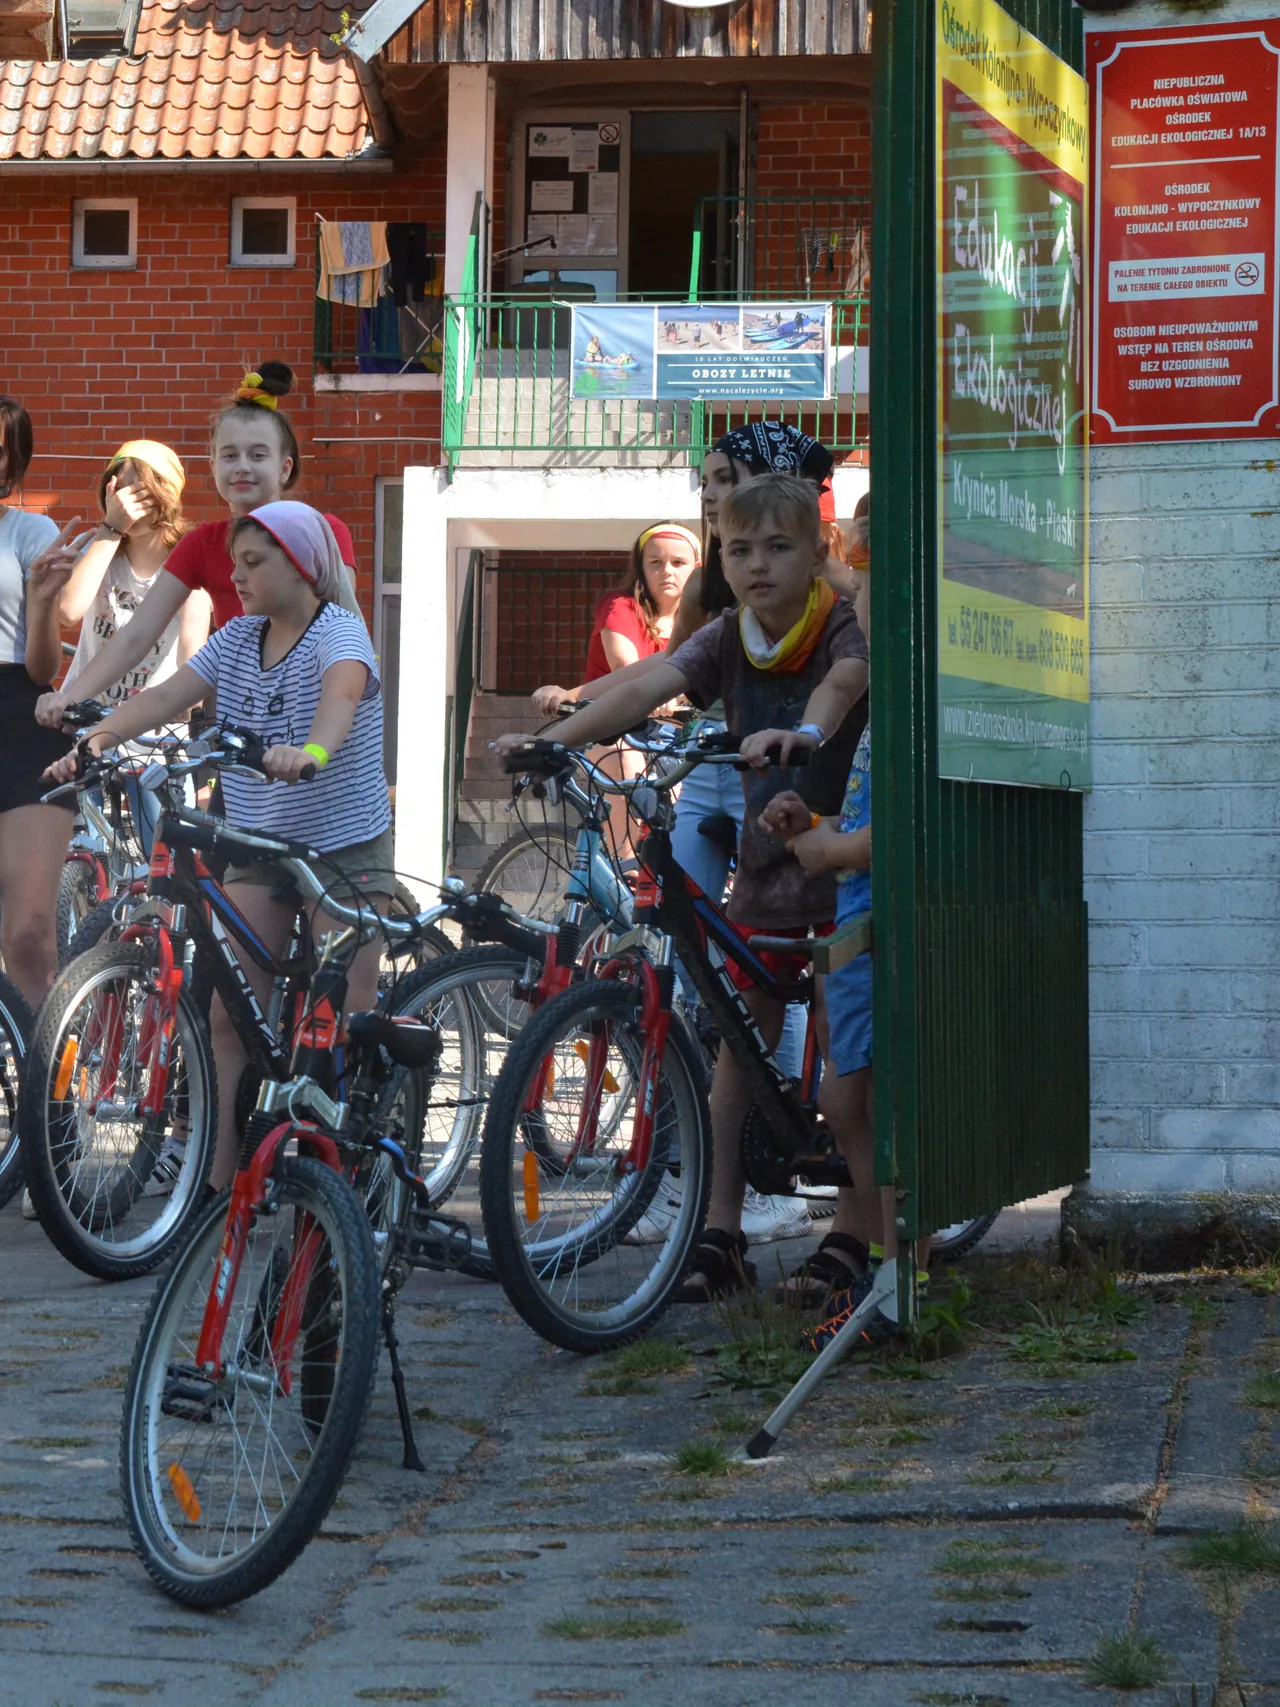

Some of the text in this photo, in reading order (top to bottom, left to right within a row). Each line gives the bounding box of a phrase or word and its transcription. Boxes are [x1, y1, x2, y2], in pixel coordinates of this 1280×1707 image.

[942, 0, 981, 71] Ośrodek
[1026, 72, 1086, 163] Wypoczynkowy
[1153, 74, 1225, 90] NIEPUBLICZNA
[1130, 90, 1248, 110] PLACÓWKA OŚWIATOWA
[1165, 111, 1212, 125] OŚRODEK
[1111, 126, 1267, 147] EDUKACJI EKOLOGICZNEJ 1A/13
[1164, 182, 1211, 196] OŚRODEK
[1114, 203, 1169, 217] KOLONIJNO
[1177, 197, 1261, 214] WYPOCZYNKOWY
[1125, 217, 1249, 235] EDUKACJI EKOLOGICZNEJ
[954, 179, 1041, 346] Edukacji
[1114, 263, 1232, 278] PALENIE TYTONIU ZABRONIONE
[1116, 278, 1228, 293] NA TERENIE CAŁEGO OBIEKTU
[1113, 320, 1259, 338] OSOBOM NIEUPOWAŻNIONYM
[1117, 338, 1254, 357] WSTĘP NA TEREN OŚRODKA
[726, 354, 788, 362] DOŚWIADCZEŃ
[1140, 357, 1230, 372] BEZ UZGODNIENIA
[691, 368, 792, 379] OBOZY LETNIE
[1128, 374, 1242, 390] SUROWO WZBRONIONY
[698, 386, 785, 395] www.nacalezycie.org
[954, 322, 1067, 477] Ekologicznej
[954, 459, 996, 521] Krynica
[999, 479, 1037, 534] Morska
[1046, 498, 1076, 549] Piaski
